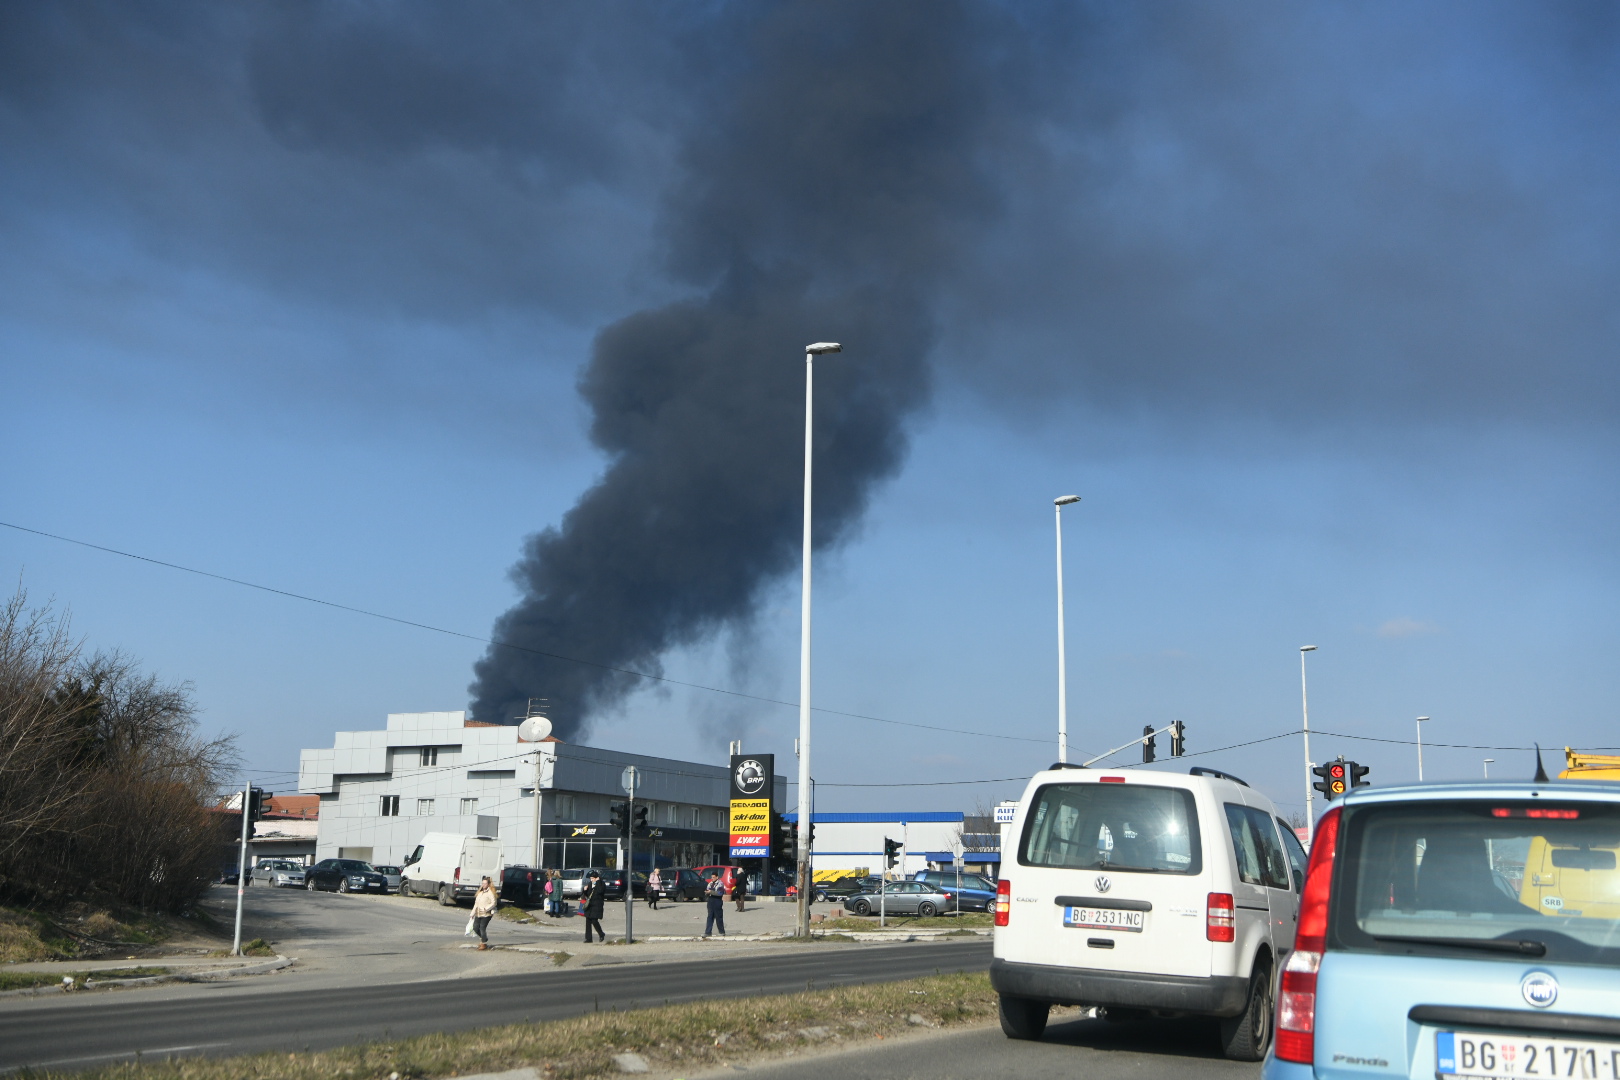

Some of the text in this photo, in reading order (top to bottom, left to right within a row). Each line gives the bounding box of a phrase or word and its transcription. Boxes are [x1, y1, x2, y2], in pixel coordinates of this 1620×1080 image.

[1544, 898, 1561, 906] SRB
[1073, 909, 1087, 922] BG
[1333, 1054, 1389, 1067] Panda
[1461, 1040, 1496, 1071] BG
